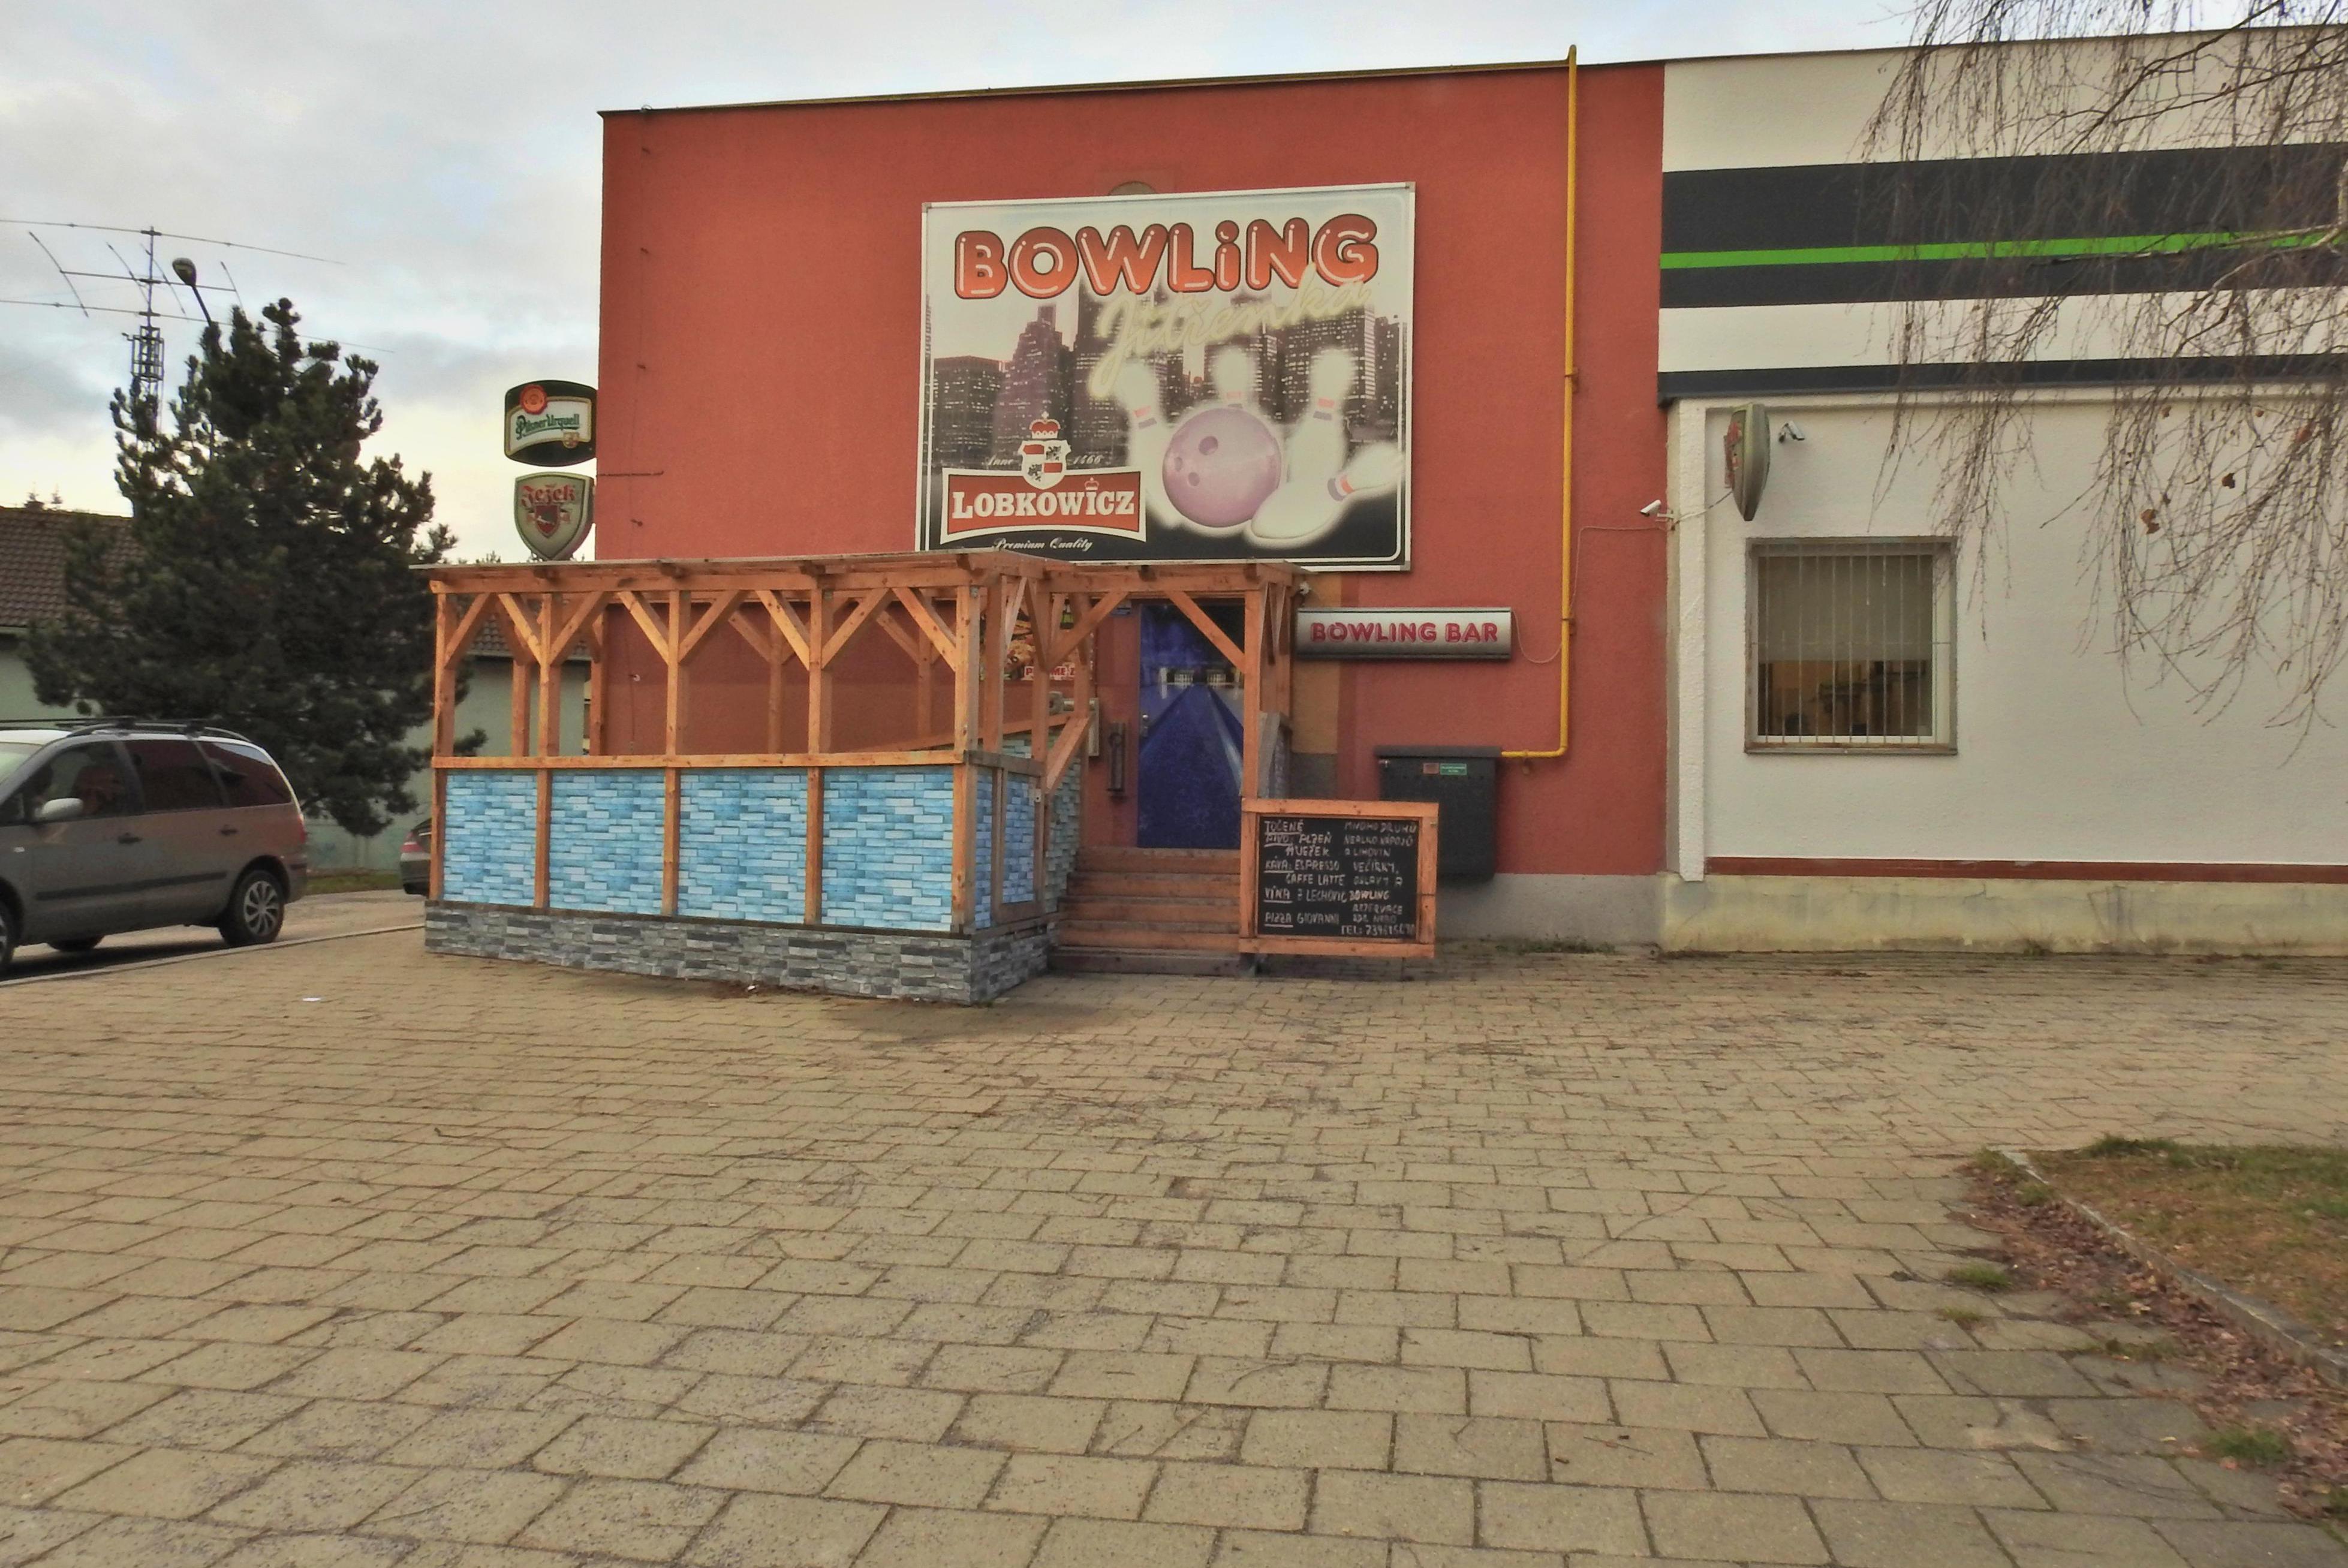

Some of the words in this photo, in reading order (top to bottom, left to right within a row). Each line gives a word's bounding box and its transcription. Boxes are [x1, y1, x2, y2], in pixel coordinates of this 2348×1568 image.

[546, 413, 580, 431] Urquell
[952, 490, 1135, 519] LOBKOWICZ
[992, 537, 1044, 552] Premium
[1049, 537, 1093, 551] Quality
[1310, 622, 1437, 643] BOWLING
[1444, 622, 1498, 643] BAR
[1264, 820, 1304, 832] TOČENÉ
[1295, 859, 1340, 871] ESPRESSO
[1318, 874, 1345, 886] LATTE
[1265, 911, 1292, 923] PIZZA
